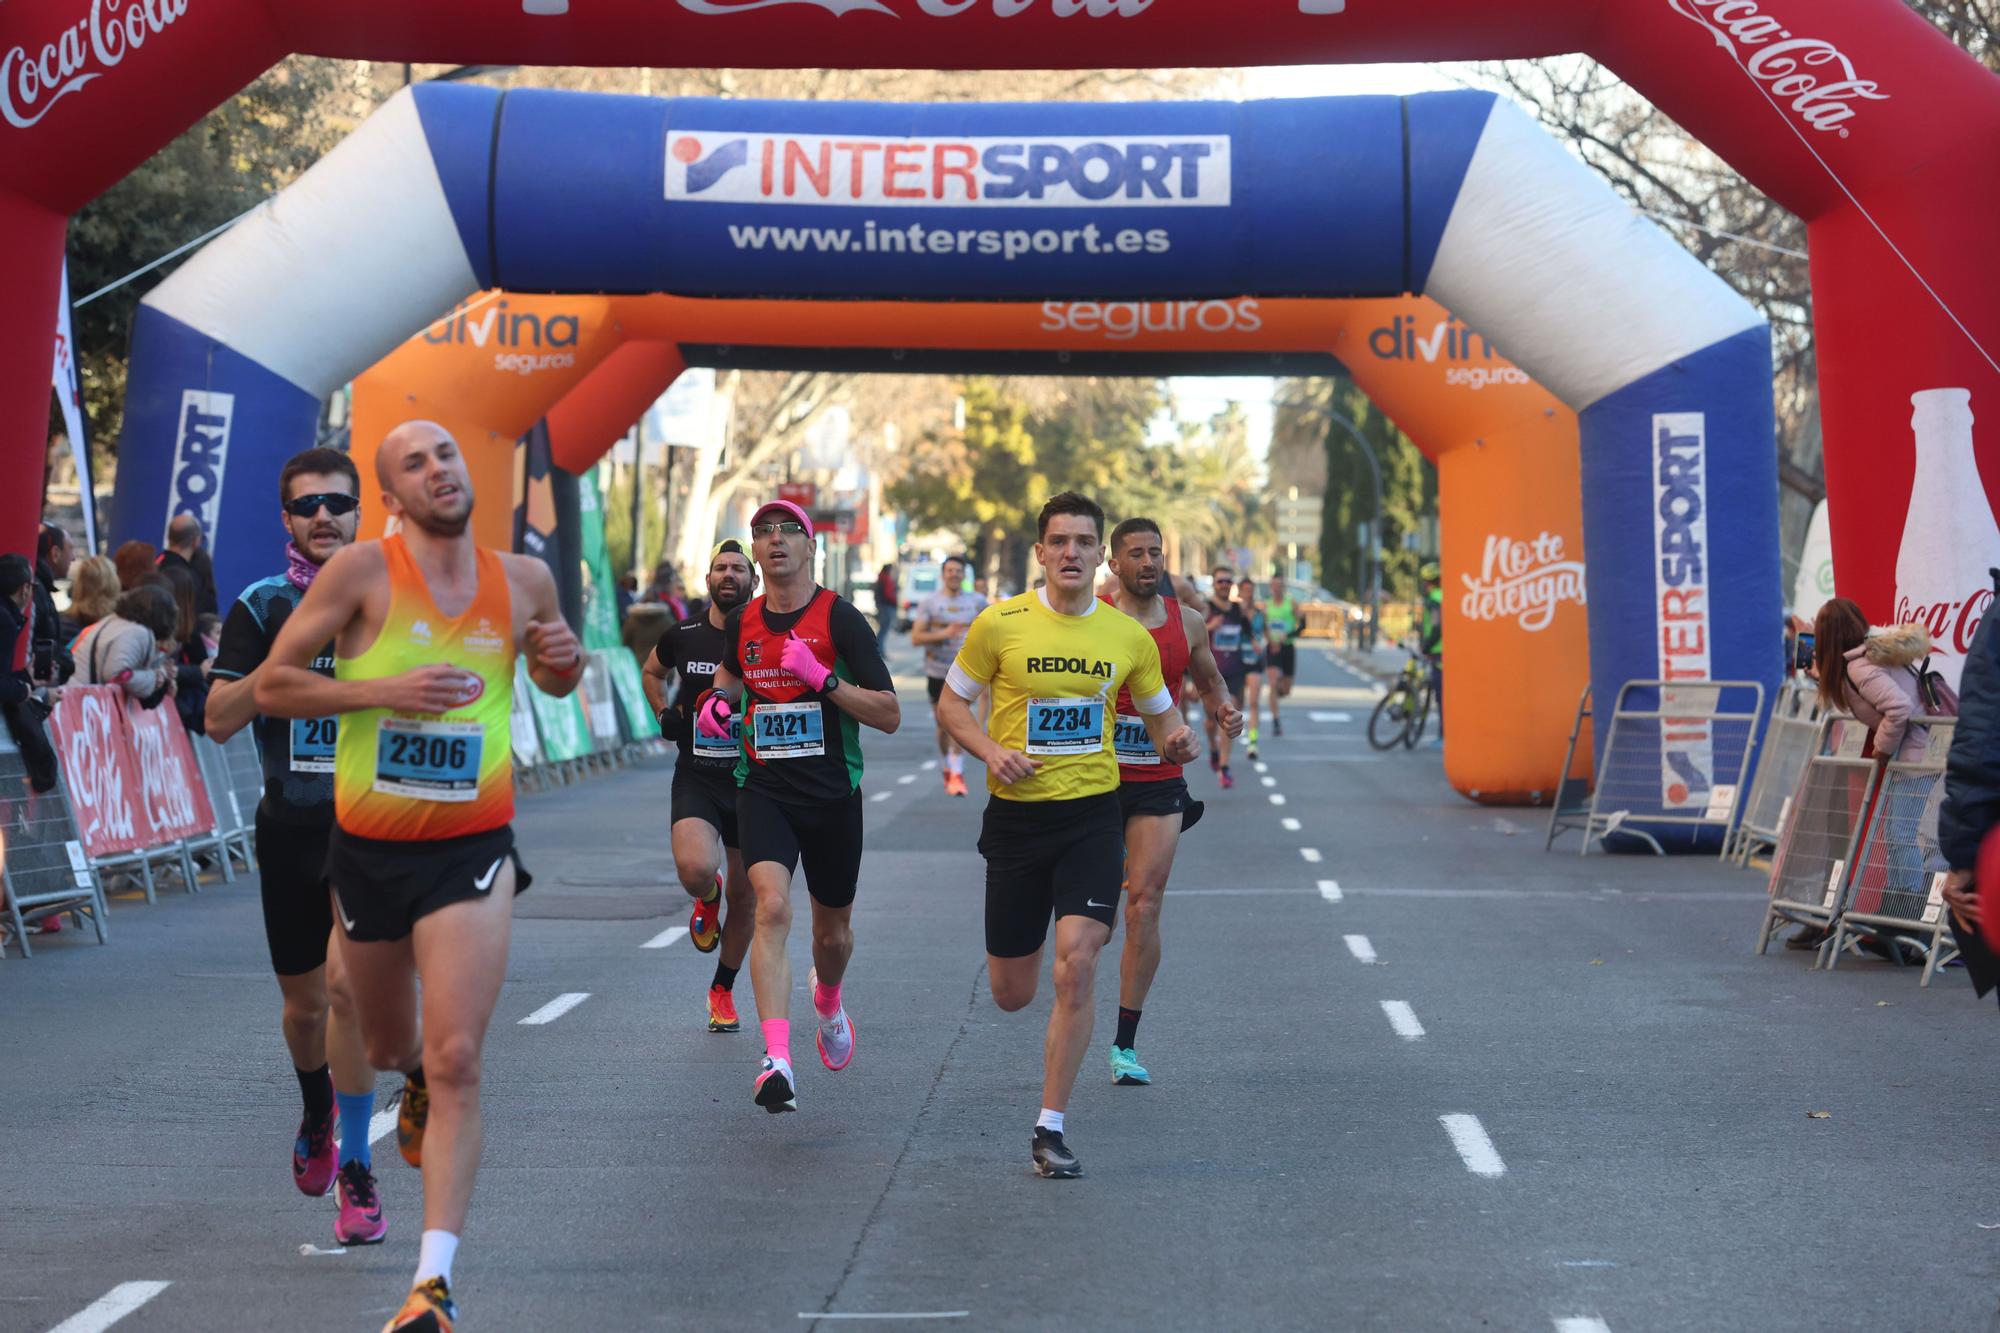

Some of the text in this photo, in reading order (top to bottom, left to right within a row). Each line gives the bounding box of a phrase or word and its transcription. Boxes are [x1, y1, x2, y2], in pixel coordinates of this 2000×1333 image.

[1668, 0, 1891, 132] ca-Cola
[760, 138, 1211, 200] INTERSPORT
[728, 221, 1171, 260] www.intersport.es
[1040, 299, 1263, 339] seguros
[495, 352, 574, 375] seguros
[1446, 367, 1529, 390] seguros
[172, 404, 226, 548] PORT
[1482, 531, 1565, 582] No te
[753, 668, 780, 678] KENYAN
[763, 714, 808, 737] 2321
[1038, 707, 1092, 731] 2234
[1113, 723, 1151, 744] 2114
[389, 735, 467, 769] 2306
